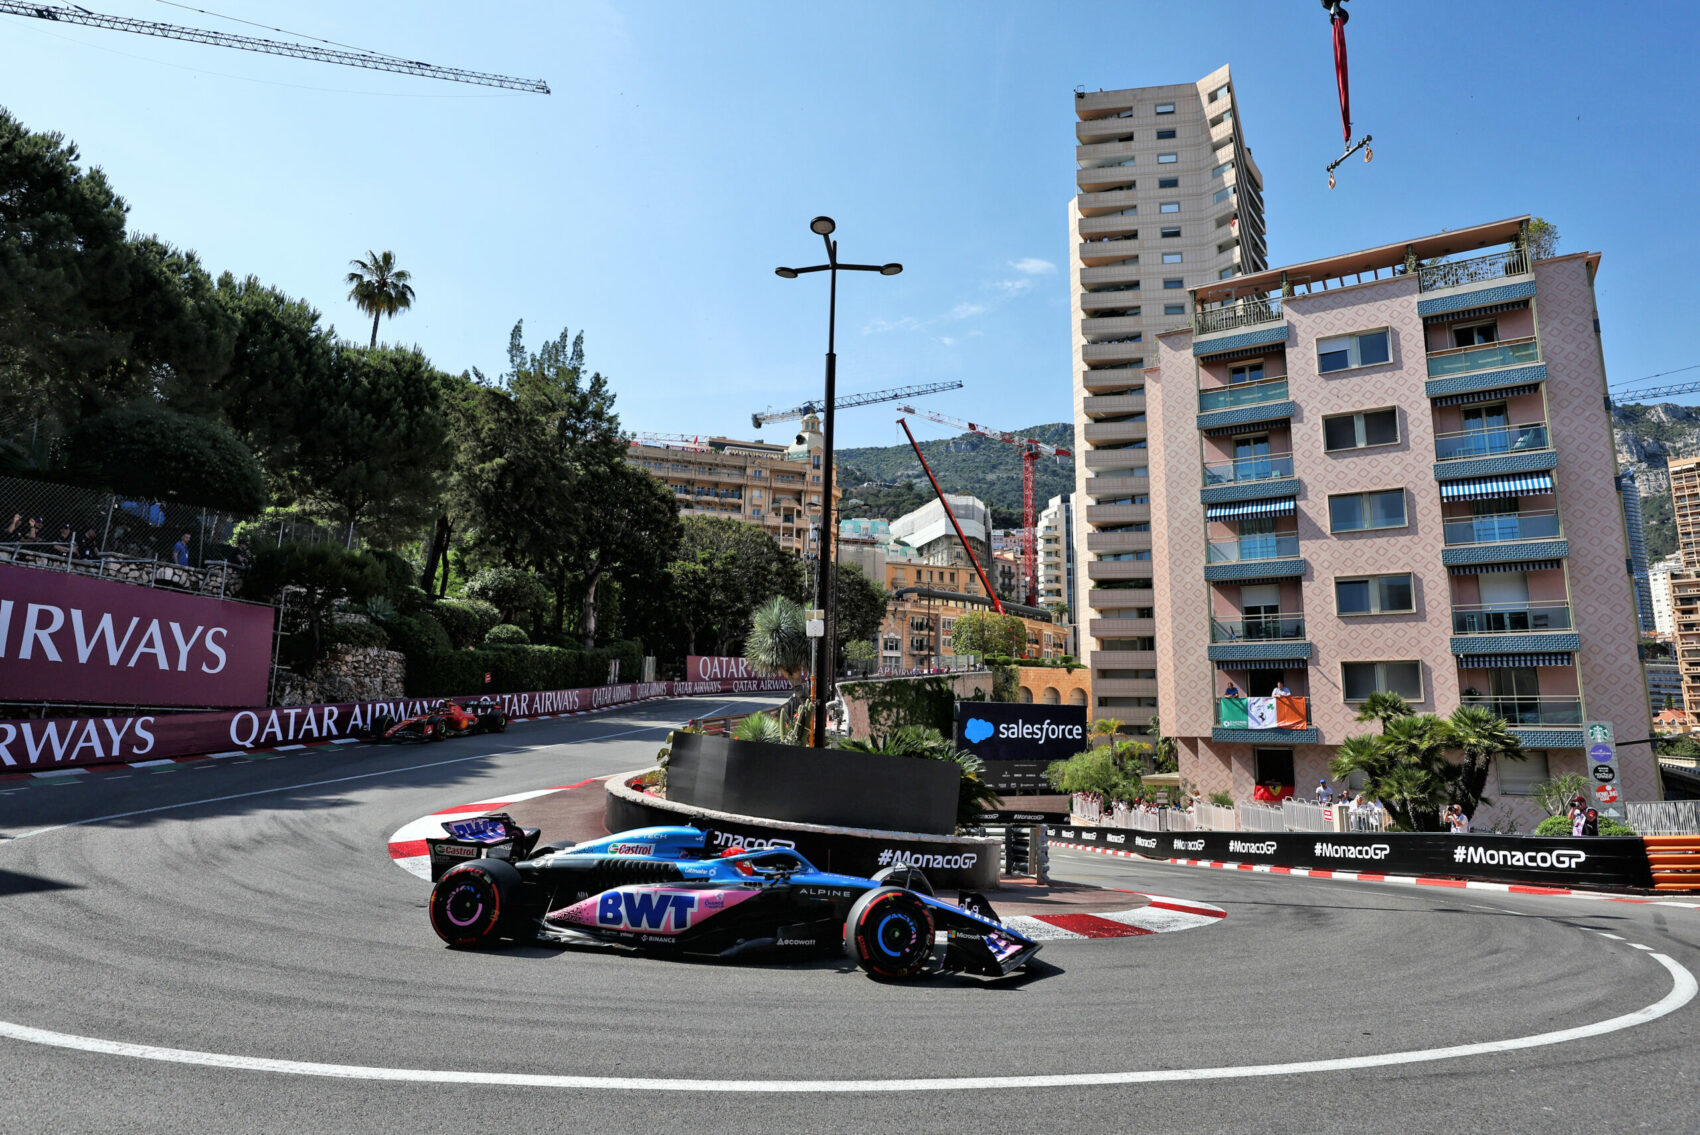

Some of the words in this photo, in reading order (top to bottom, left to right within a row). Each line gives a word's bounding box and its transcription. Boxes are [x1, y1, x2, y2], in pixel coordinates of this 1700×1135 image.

[699, 656, 748, 681] QATAR
[673, 682, 692, 695] QATAR
[693, 681, 722, 693] AIRWAYS
[732, 680, 758, 693] QATAR
[759, 679, 793, 692] AIRWAYS
[531, 690, 579, 714] AIRWAYS
[592, 686, 612, 708] QATAR
[230, 706, 338, 748] QATAR
[998, 718, 1083, 744] salesforce
[445, 845, 475, 857] Castrol
[618, 844, 653, 855] Castrol
[1173, 838, 1205, 850] #MonacoGP
[1229, 839, 1277, 855] #MonacoGP
[1314, 842, 1390, 860] #MonacoGP
[878, 849, 977, 869] #MonacoGP
[1453, 845, 1586, 869] #MonacoGP
[800, 888, 851, 898] ALPINE
[599, 890, 696, 930] BWT
[783, 937, 817, 945] ecowatt
[957, 932, 981, 941] Microsoft
